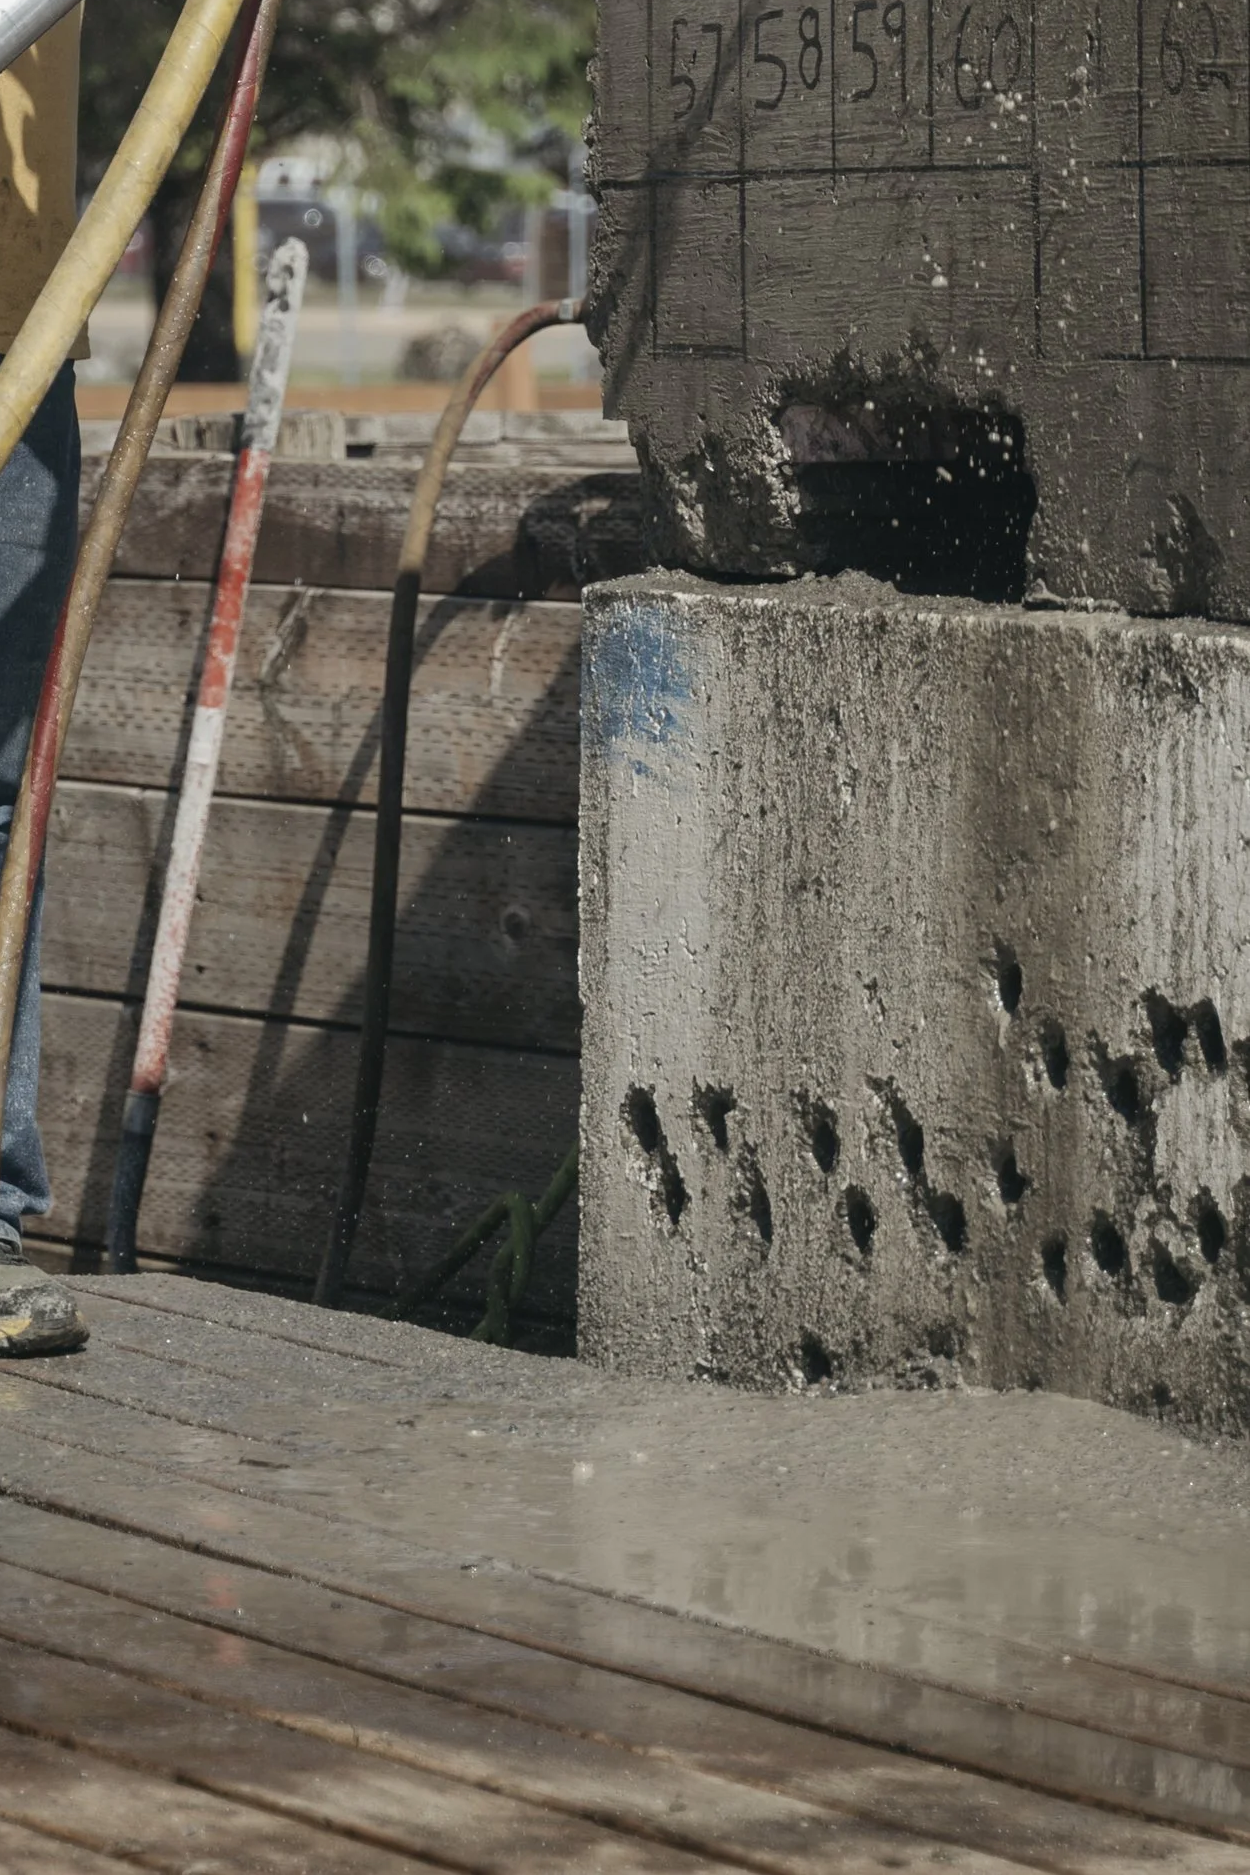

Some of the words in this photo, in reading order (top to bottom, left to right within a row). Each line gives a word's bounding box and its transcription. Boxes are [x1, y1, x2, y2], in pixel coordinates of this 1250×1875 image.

[670, 18, 724, 122] 57
[753, 7, 823, 110] 58
[849, 0, 908, 106] 59
[954, 4, 1022, 110] 60
